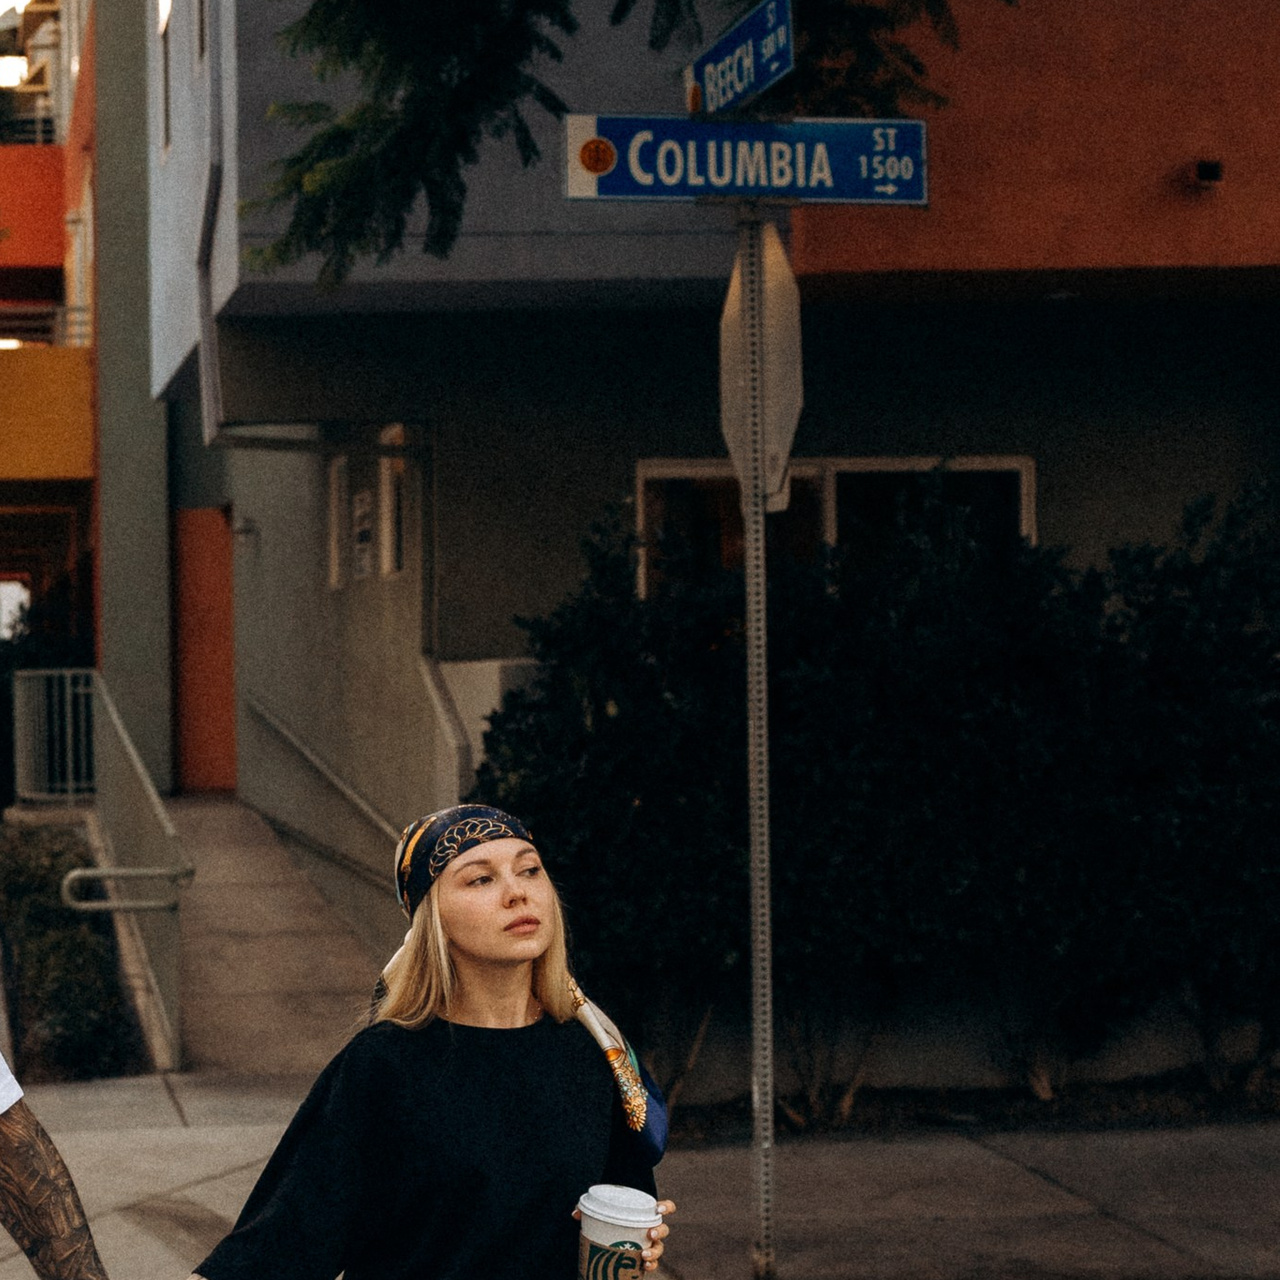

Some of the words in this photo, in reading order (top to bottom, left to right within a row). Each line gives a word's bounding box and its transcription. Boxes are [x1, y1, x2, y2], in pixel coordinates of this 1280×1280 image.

[703, 38, 756, 114] BEECH
[628, 130, 834, 189] COLUMBIA
[872, 127, 897, 152] ST
[859, 155, 915, 181] 1500
